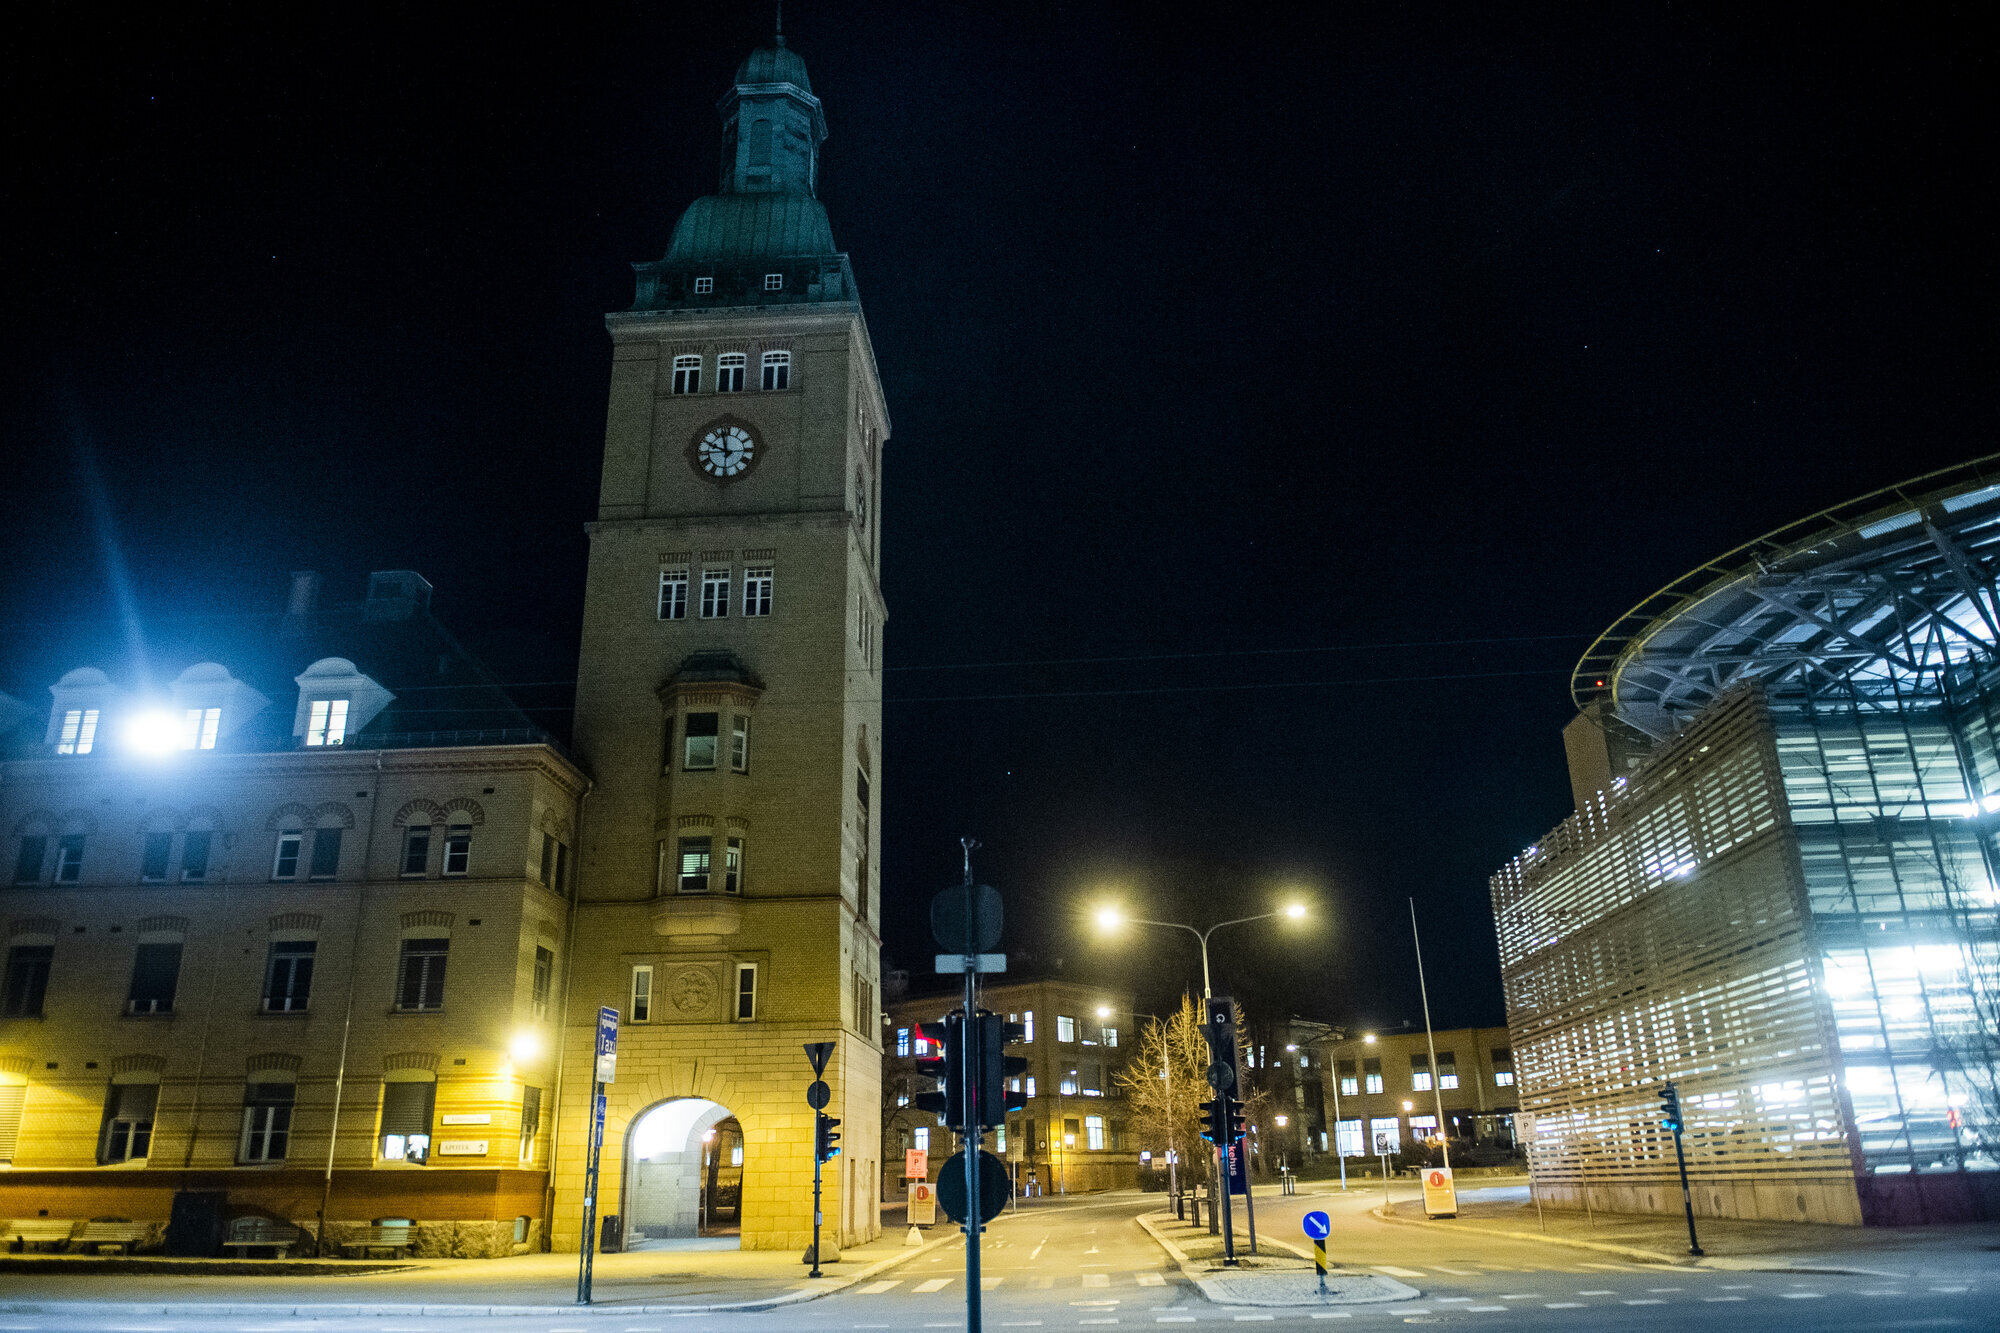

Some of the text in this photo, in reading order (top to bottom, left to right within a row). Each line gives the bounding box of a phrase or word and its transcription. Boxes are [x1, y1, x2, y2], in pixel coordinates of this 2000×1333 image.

[600, 1034, 616, 1054] Taxi
[1523, 1122, 1529, 1130] P
[914, 1158, 920, 1166] P
[1228, 1146, 1238, 1176] kehus
